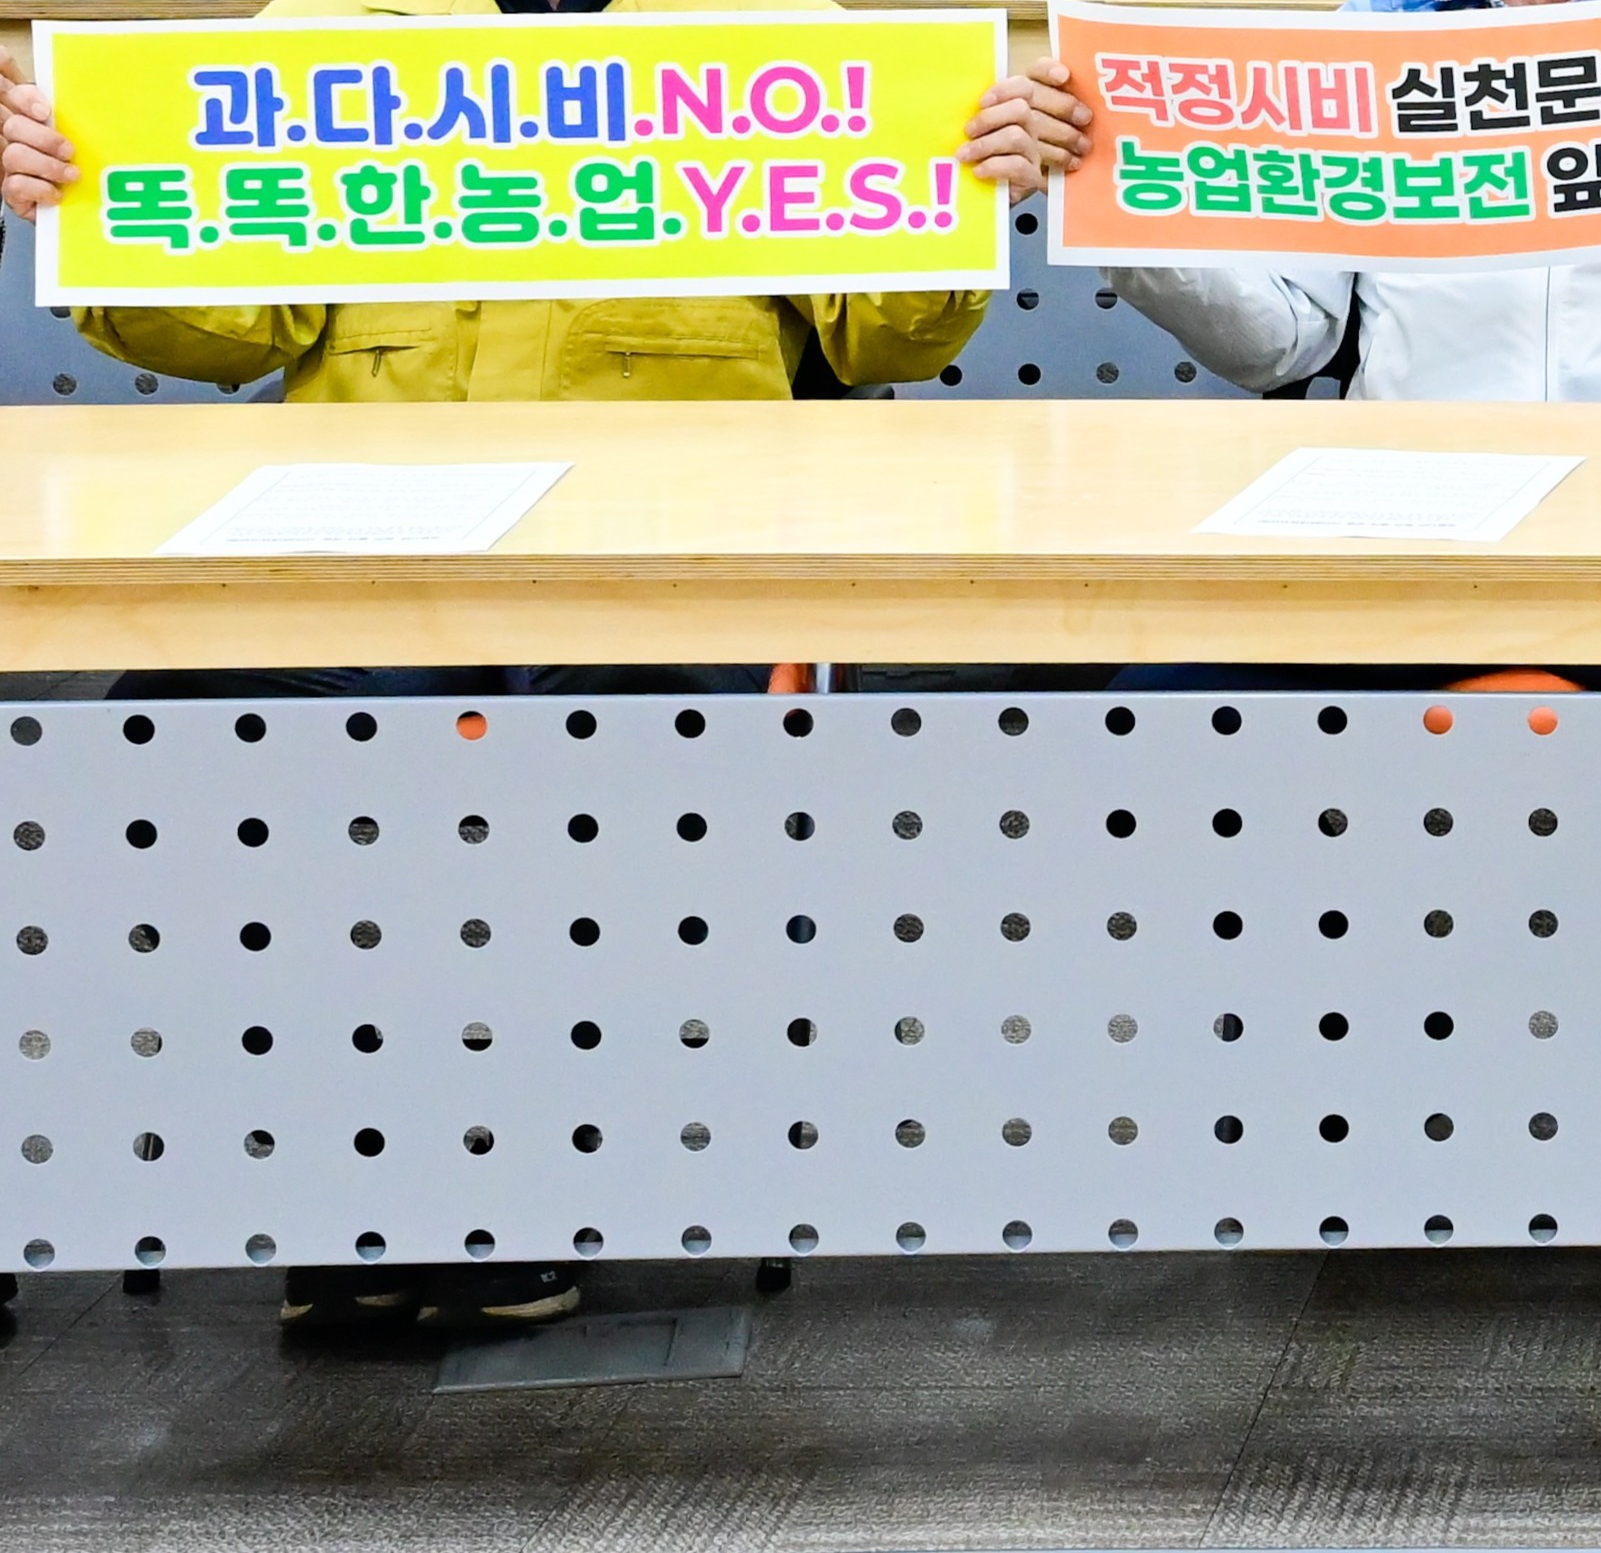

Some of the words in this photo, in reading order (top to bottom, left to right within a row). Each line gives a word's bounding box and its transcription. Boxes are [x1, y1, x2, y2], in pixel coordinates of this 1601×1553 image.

[194, 62, 866, 149] 과.다.시.비.N.O.!
[1103, 57, 1372, 136] 적정시비
[106, 160, 954, 251] 똑.똑.한.농.업.Y.E.S.!
[1118, 139, 1532, 222] 농업환경보전
